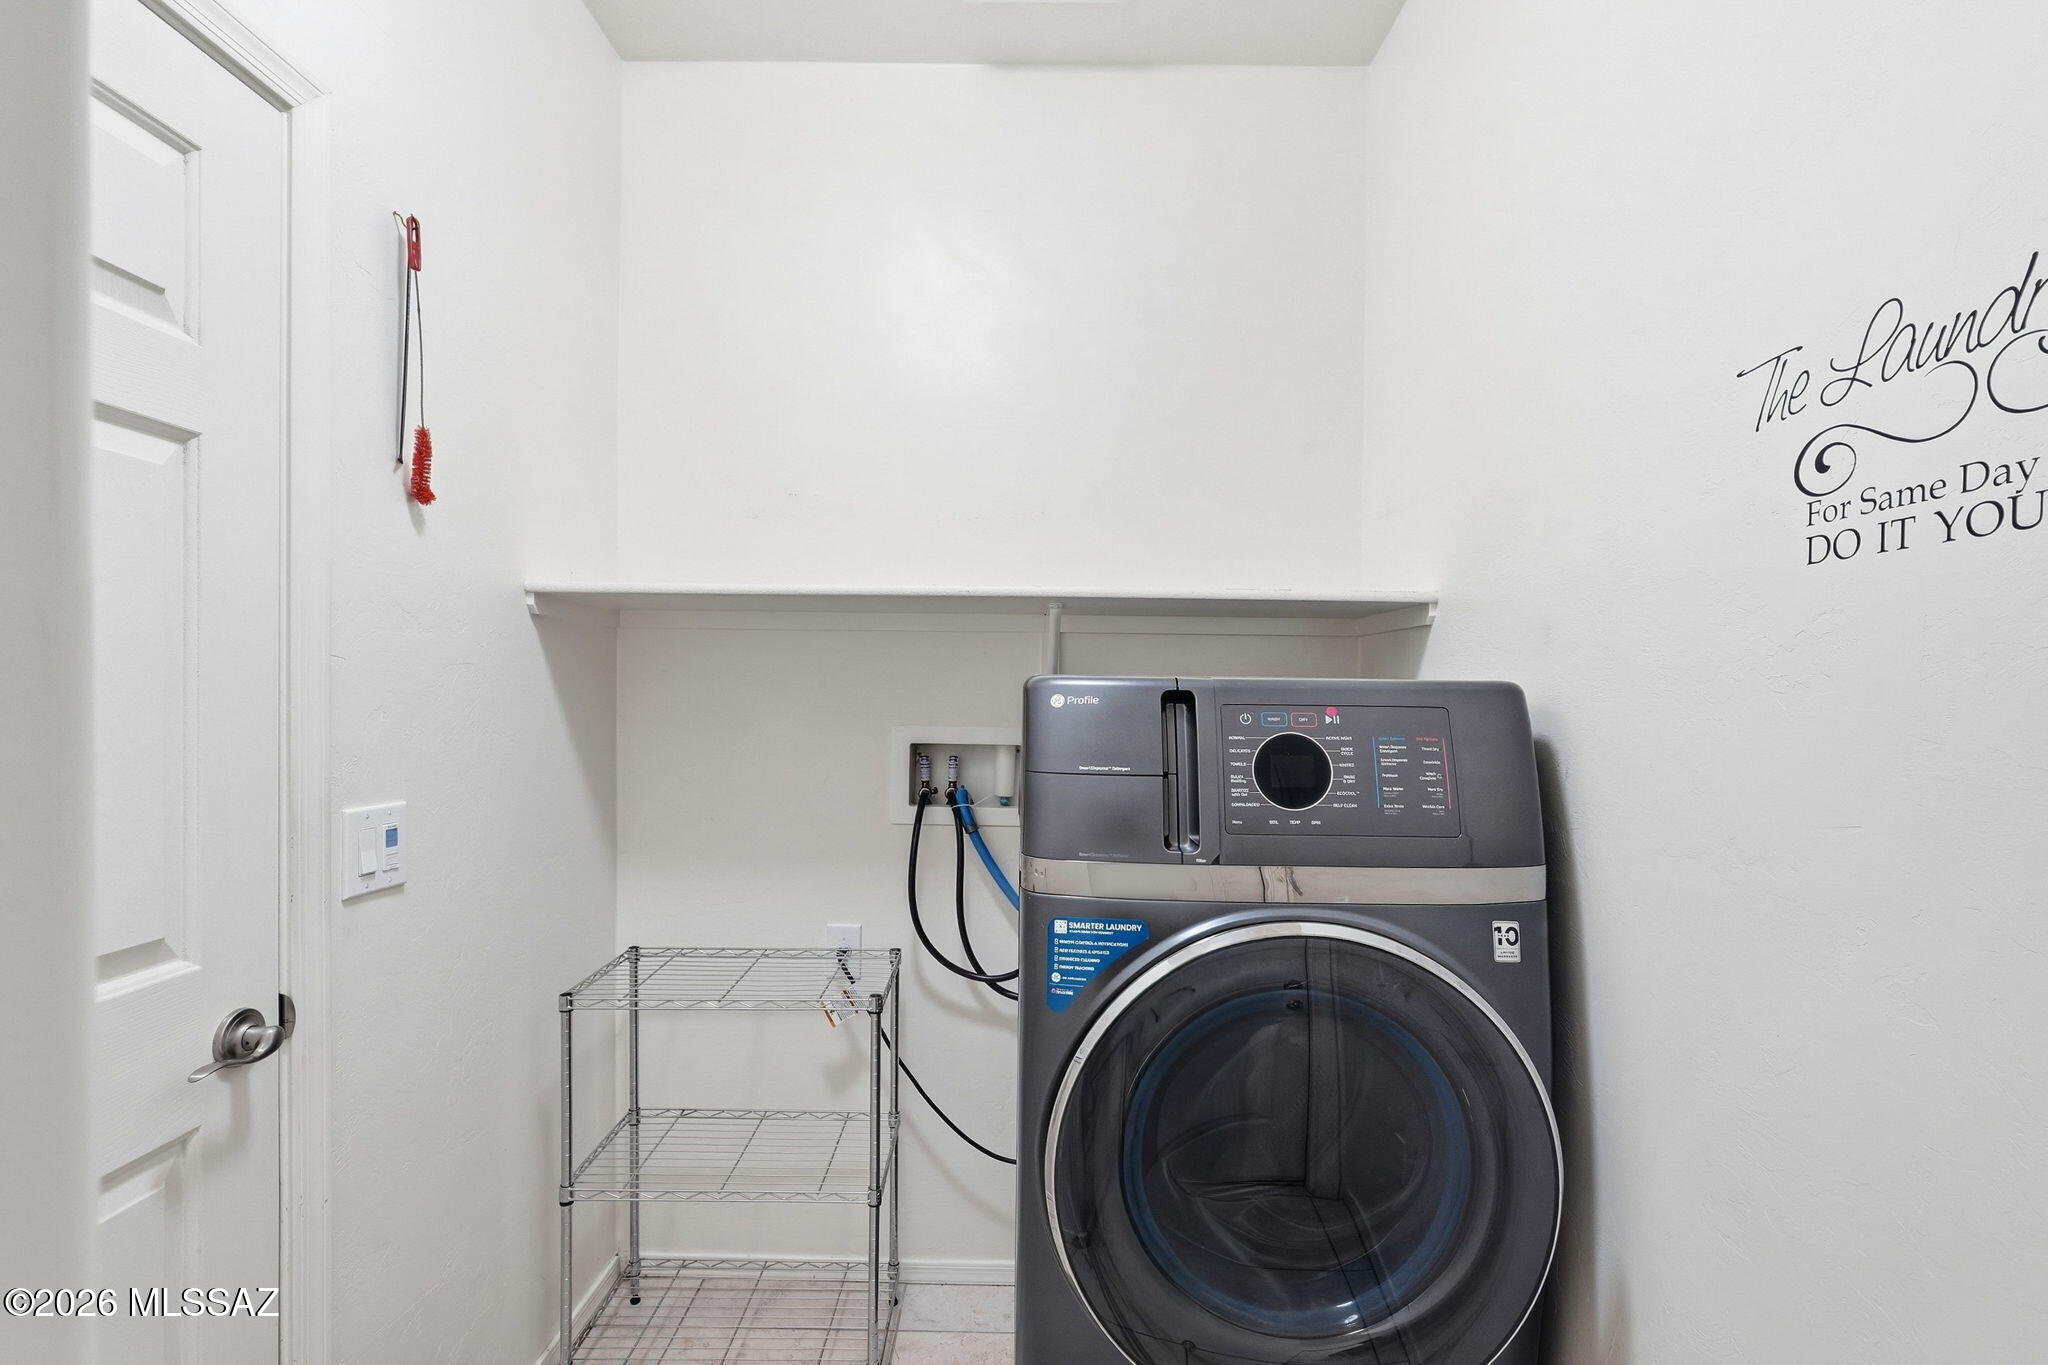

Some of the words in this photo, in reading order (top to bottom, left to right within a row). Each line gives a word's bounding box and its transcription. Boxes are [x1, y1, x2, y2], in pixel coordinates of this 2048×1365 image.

[1737, 346, 1810, 433] The
[1806, 499, 1851, 527] For
[1860, 478, 1947, 515] Same
[1959, 456, 2041, 494] Day
[1805, 528, 1862, 566] DO
[1876, 515, 1916, 554] IT
[1067, 694, 1100, 706] Profile
[1068, 921, 1104, 931] SMARTER
[1105, 923, 1143, 932] LAUNDRY
[1493, 926, 1519, 947] 10
